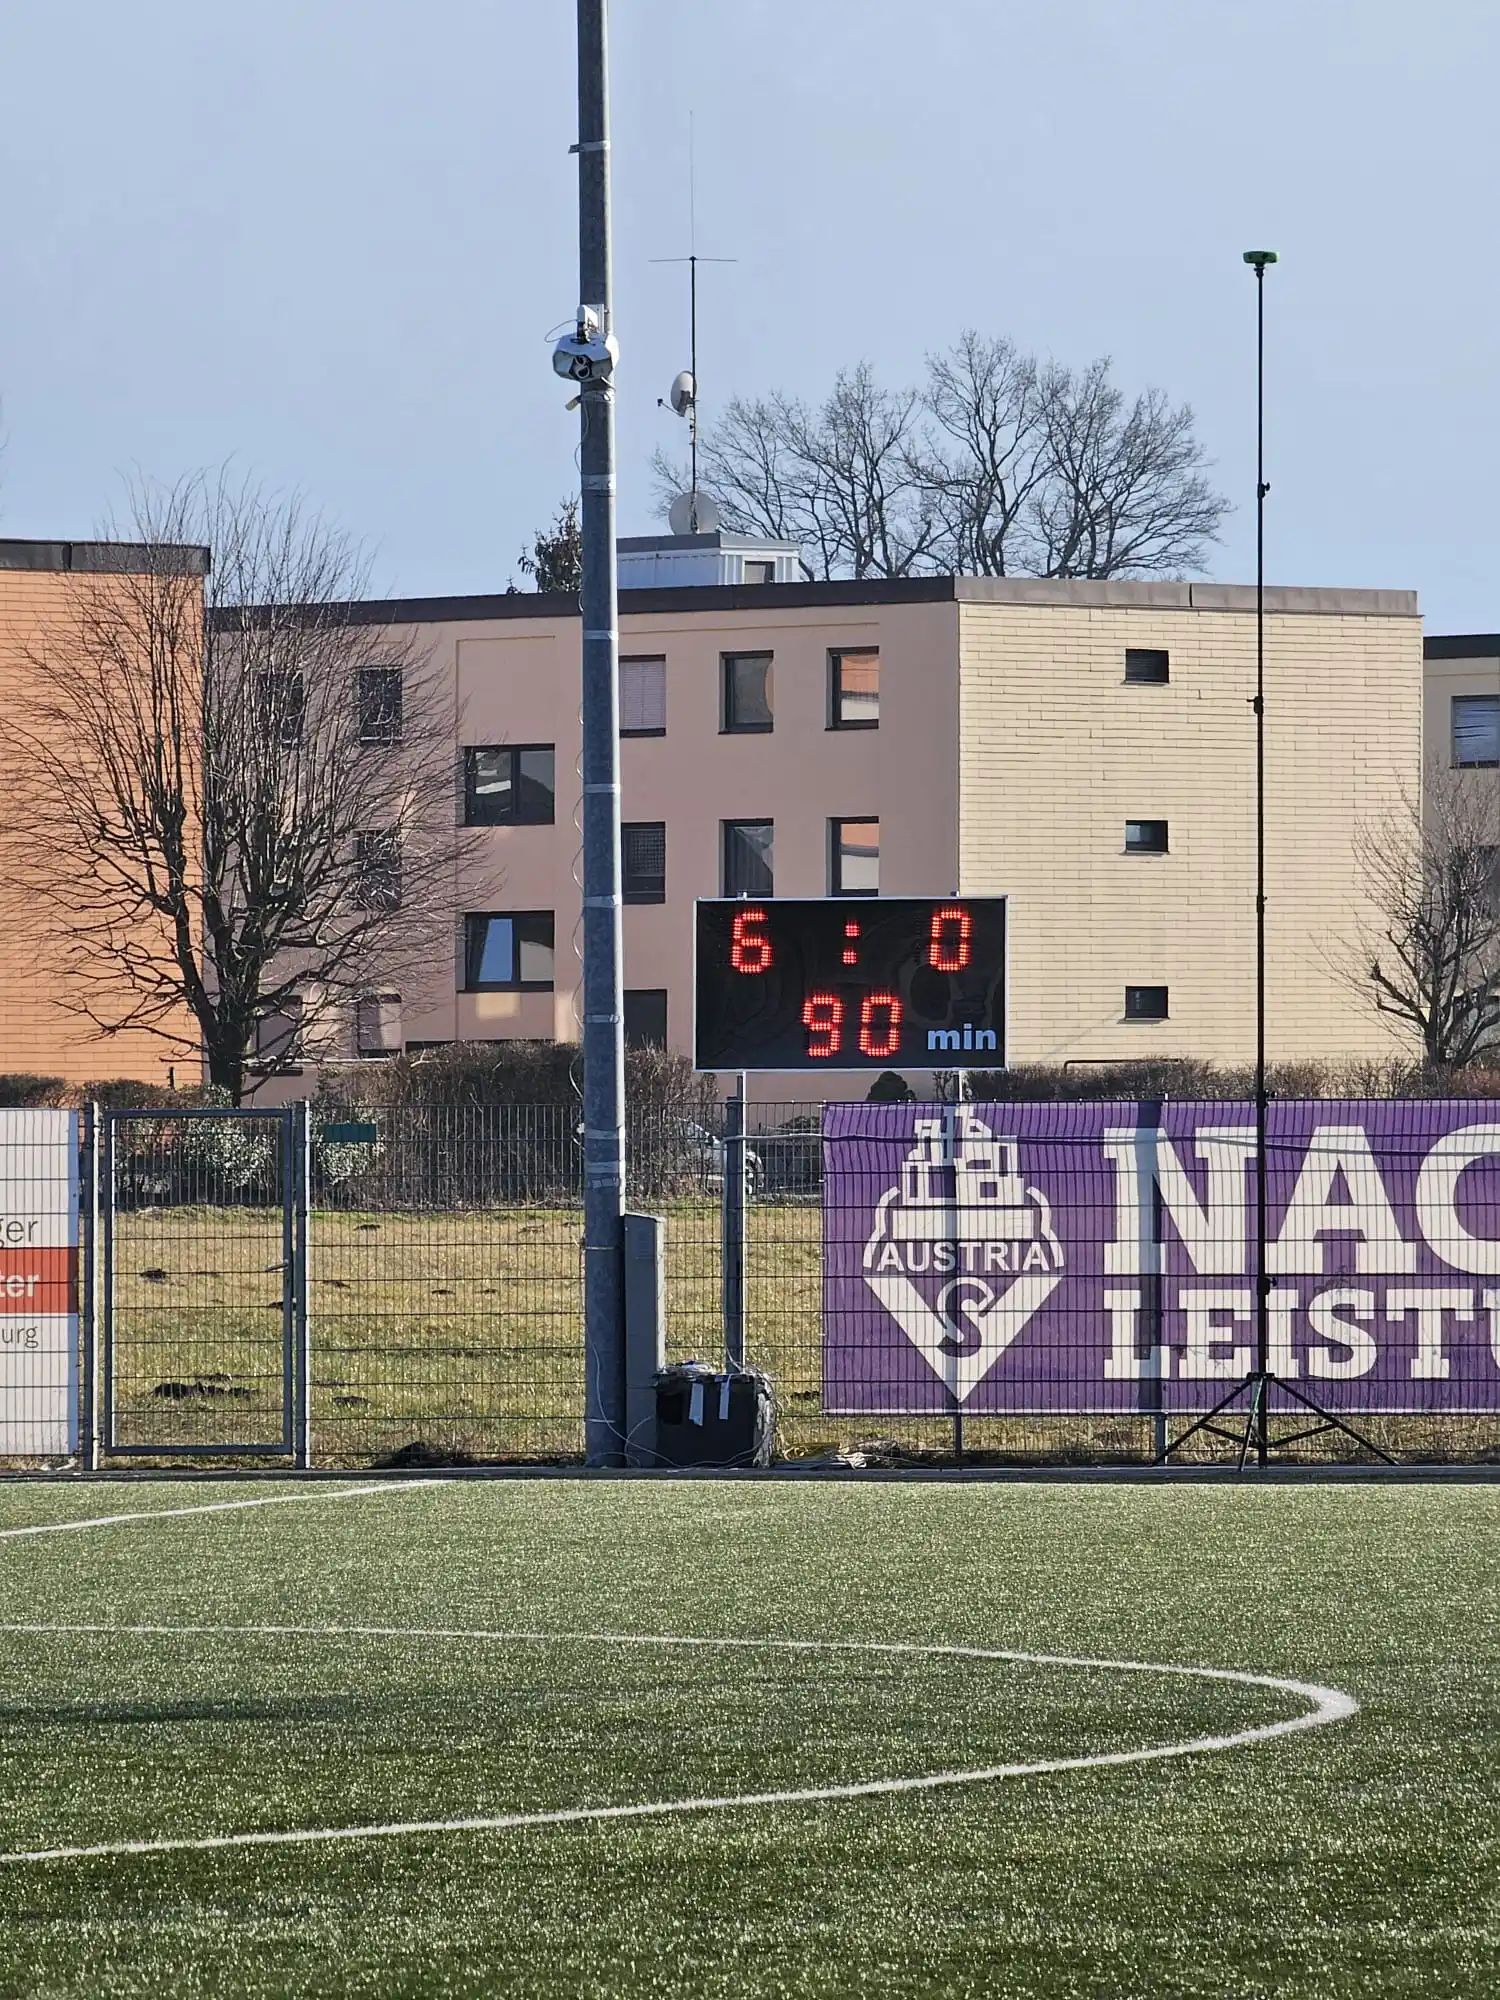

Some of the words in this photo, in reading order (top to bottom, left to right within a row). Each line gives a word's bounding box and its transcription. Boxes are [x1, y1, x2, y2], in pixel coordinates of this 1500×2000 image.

[730, 910, 773, 974] 6
[928, 909, 972, 972] 0
[802, 994, 903, 1058] 90
[926, 1023, 997, 1050] min
[0, 1218, 38, 1248] er
[876, 1242, 1050, 1272] AUSTRIA
[1103, 1287, 1500, 1379] LEIST
